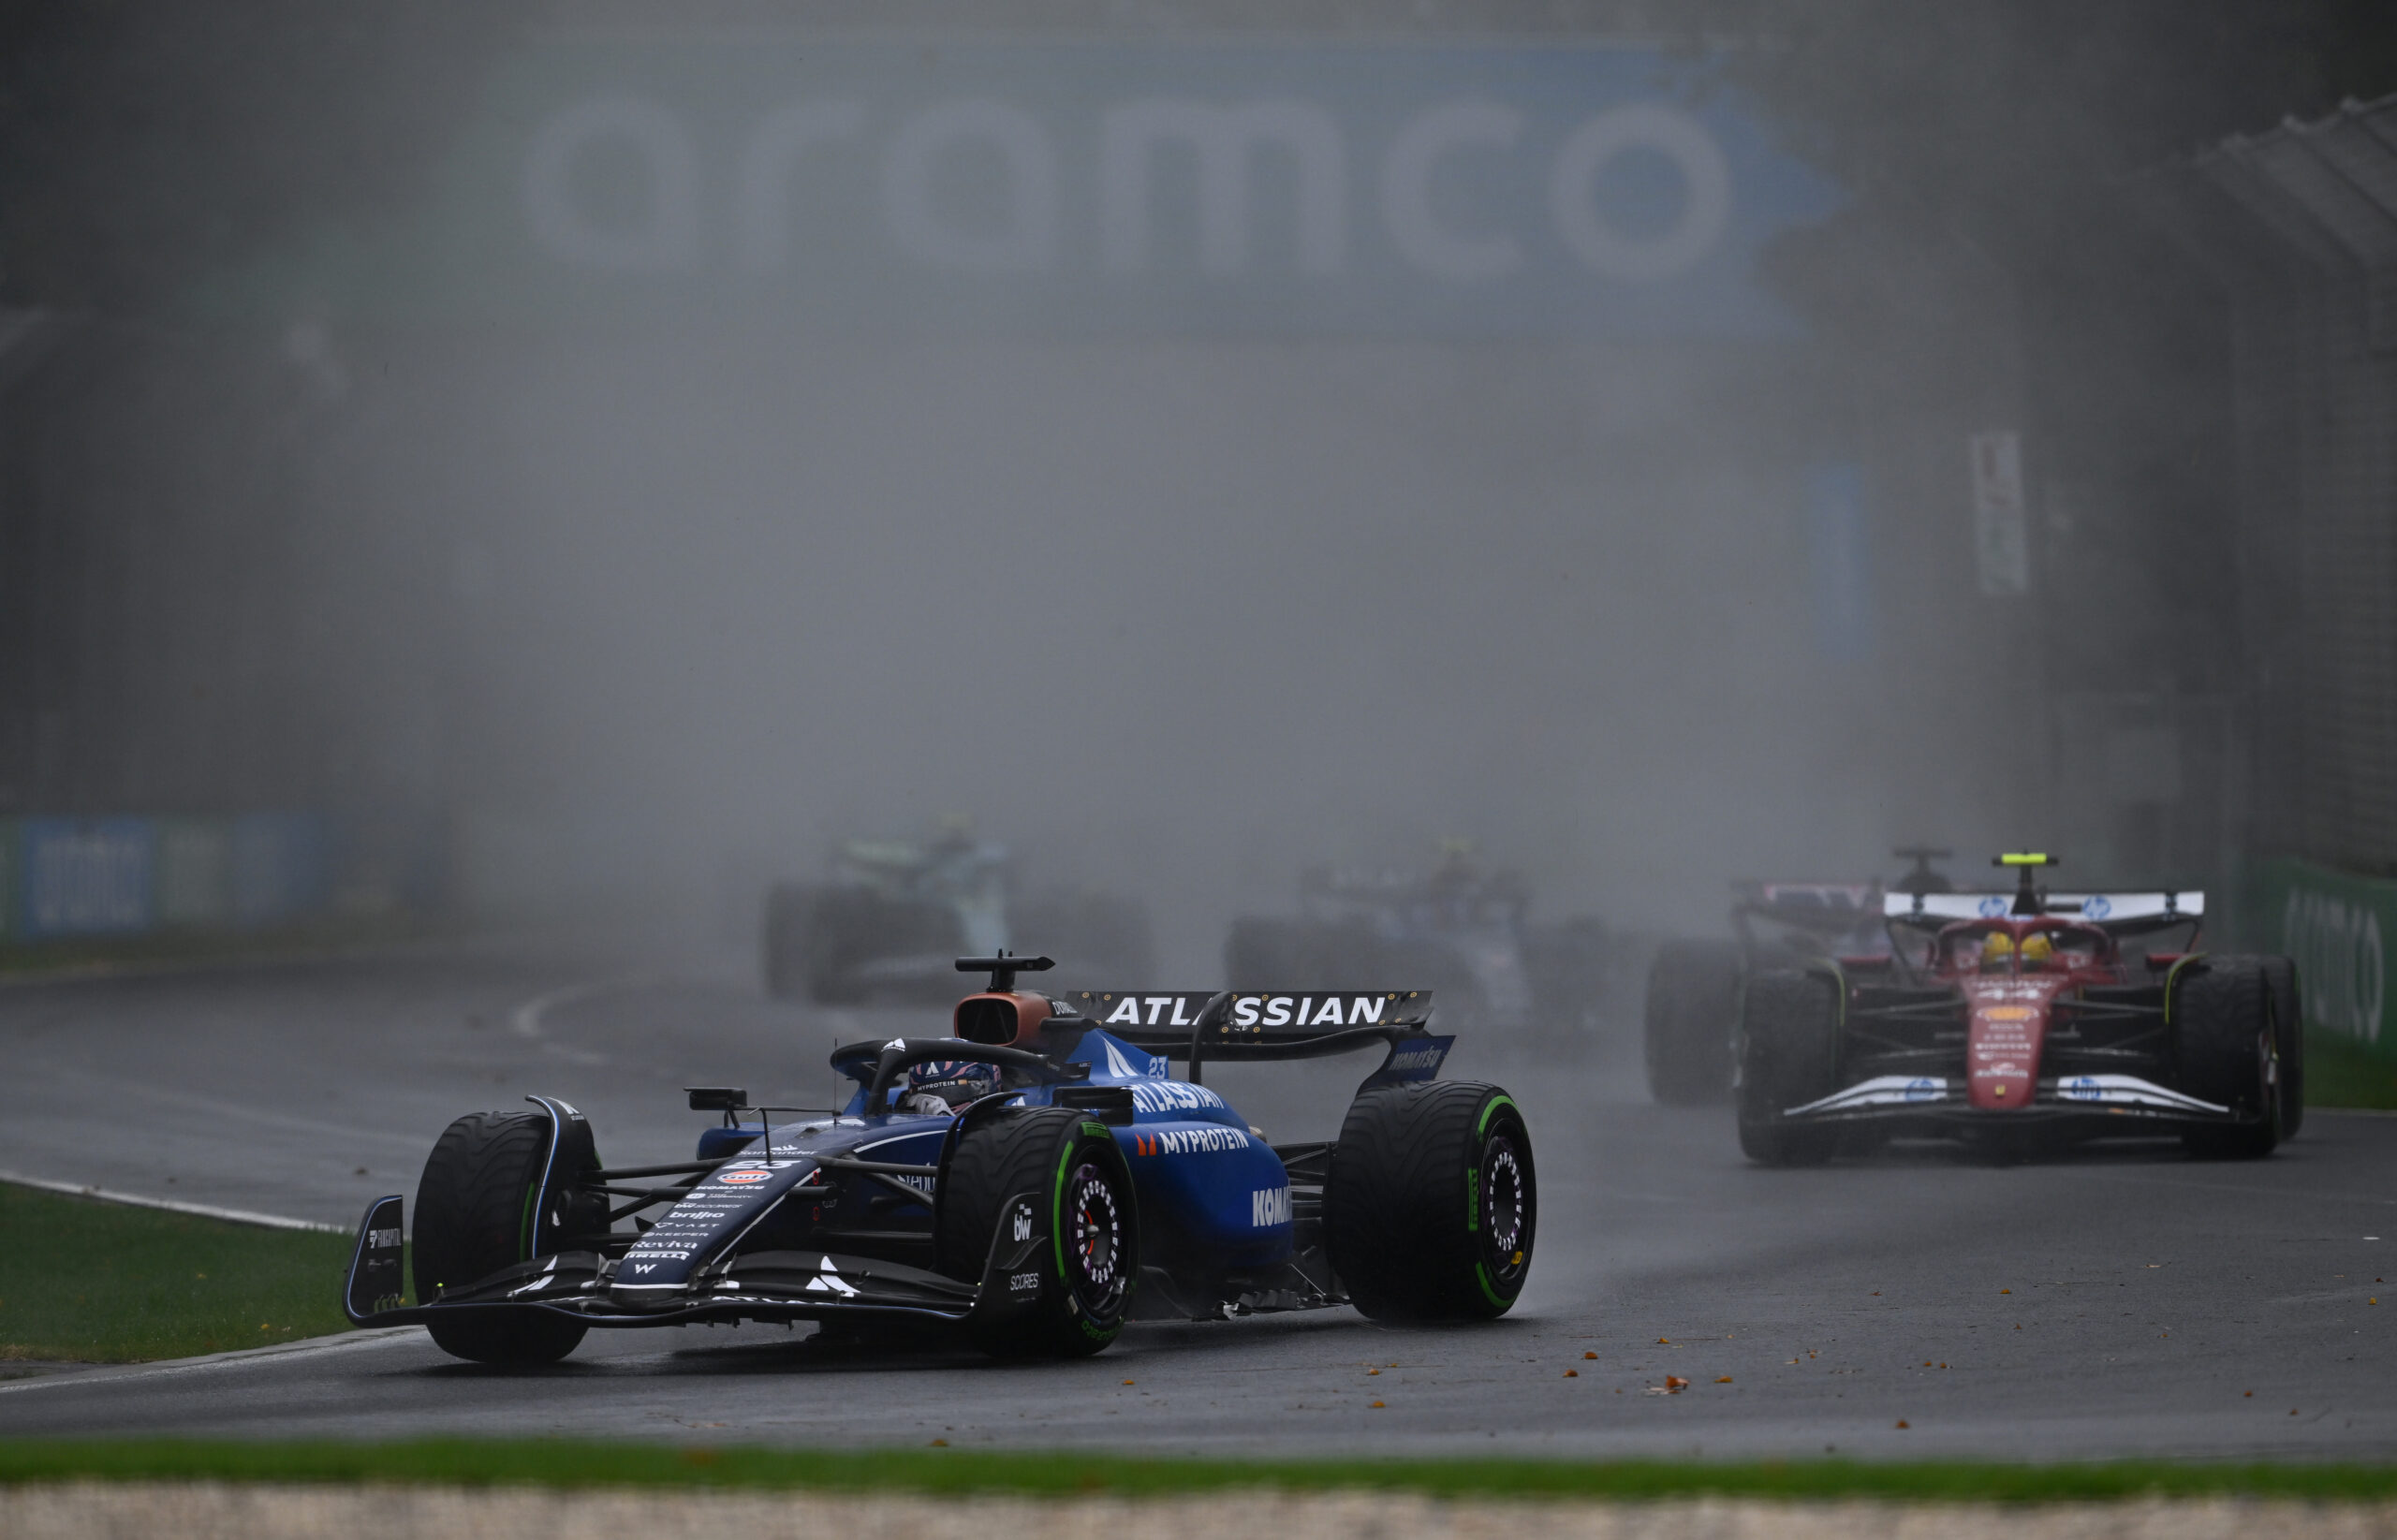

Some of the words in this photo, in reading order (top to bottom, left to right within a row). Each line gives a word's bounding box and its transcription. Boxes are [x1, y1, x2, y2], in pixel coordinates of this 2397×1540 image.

[521, 97, 1732, 280] aramco
[1106, 997, 1386, 1026] ATLSSIAN
[1148, 1057, 1168, 1079] 23
[917, 1080, 956, 1092] MYPROTEIN
[1158, 1128, 1250, 1154] MYPROTEIN
[722, 1160, 802, 1169] 23
[669, 1210, 726, 1220] brillio
[630, 1240, 698, 1250] Reviva
[1010, 1272, 1039, 1291] SCORES
